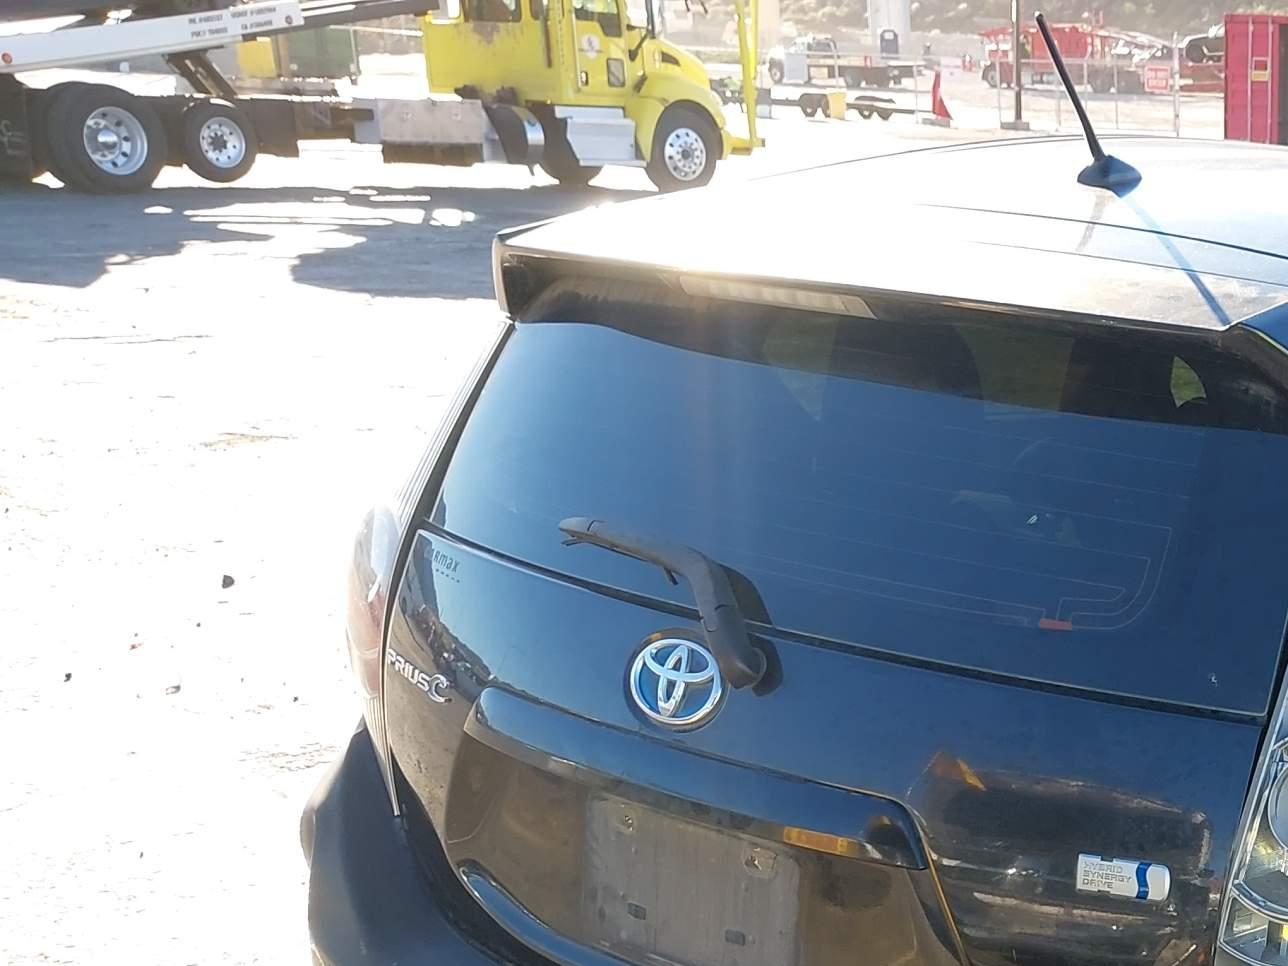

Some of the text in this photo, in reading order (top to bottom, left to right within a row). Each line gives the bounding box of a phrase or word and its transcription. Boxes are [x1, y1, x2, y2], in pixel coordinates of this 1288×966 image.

[387, 648, 431, 692] PRIUS
[1082, 861, 1124, 874] HYBRID
[1082, 869, 1132, 883] SYNERGY
[1081, 877, 1115, 889] DRIVE
